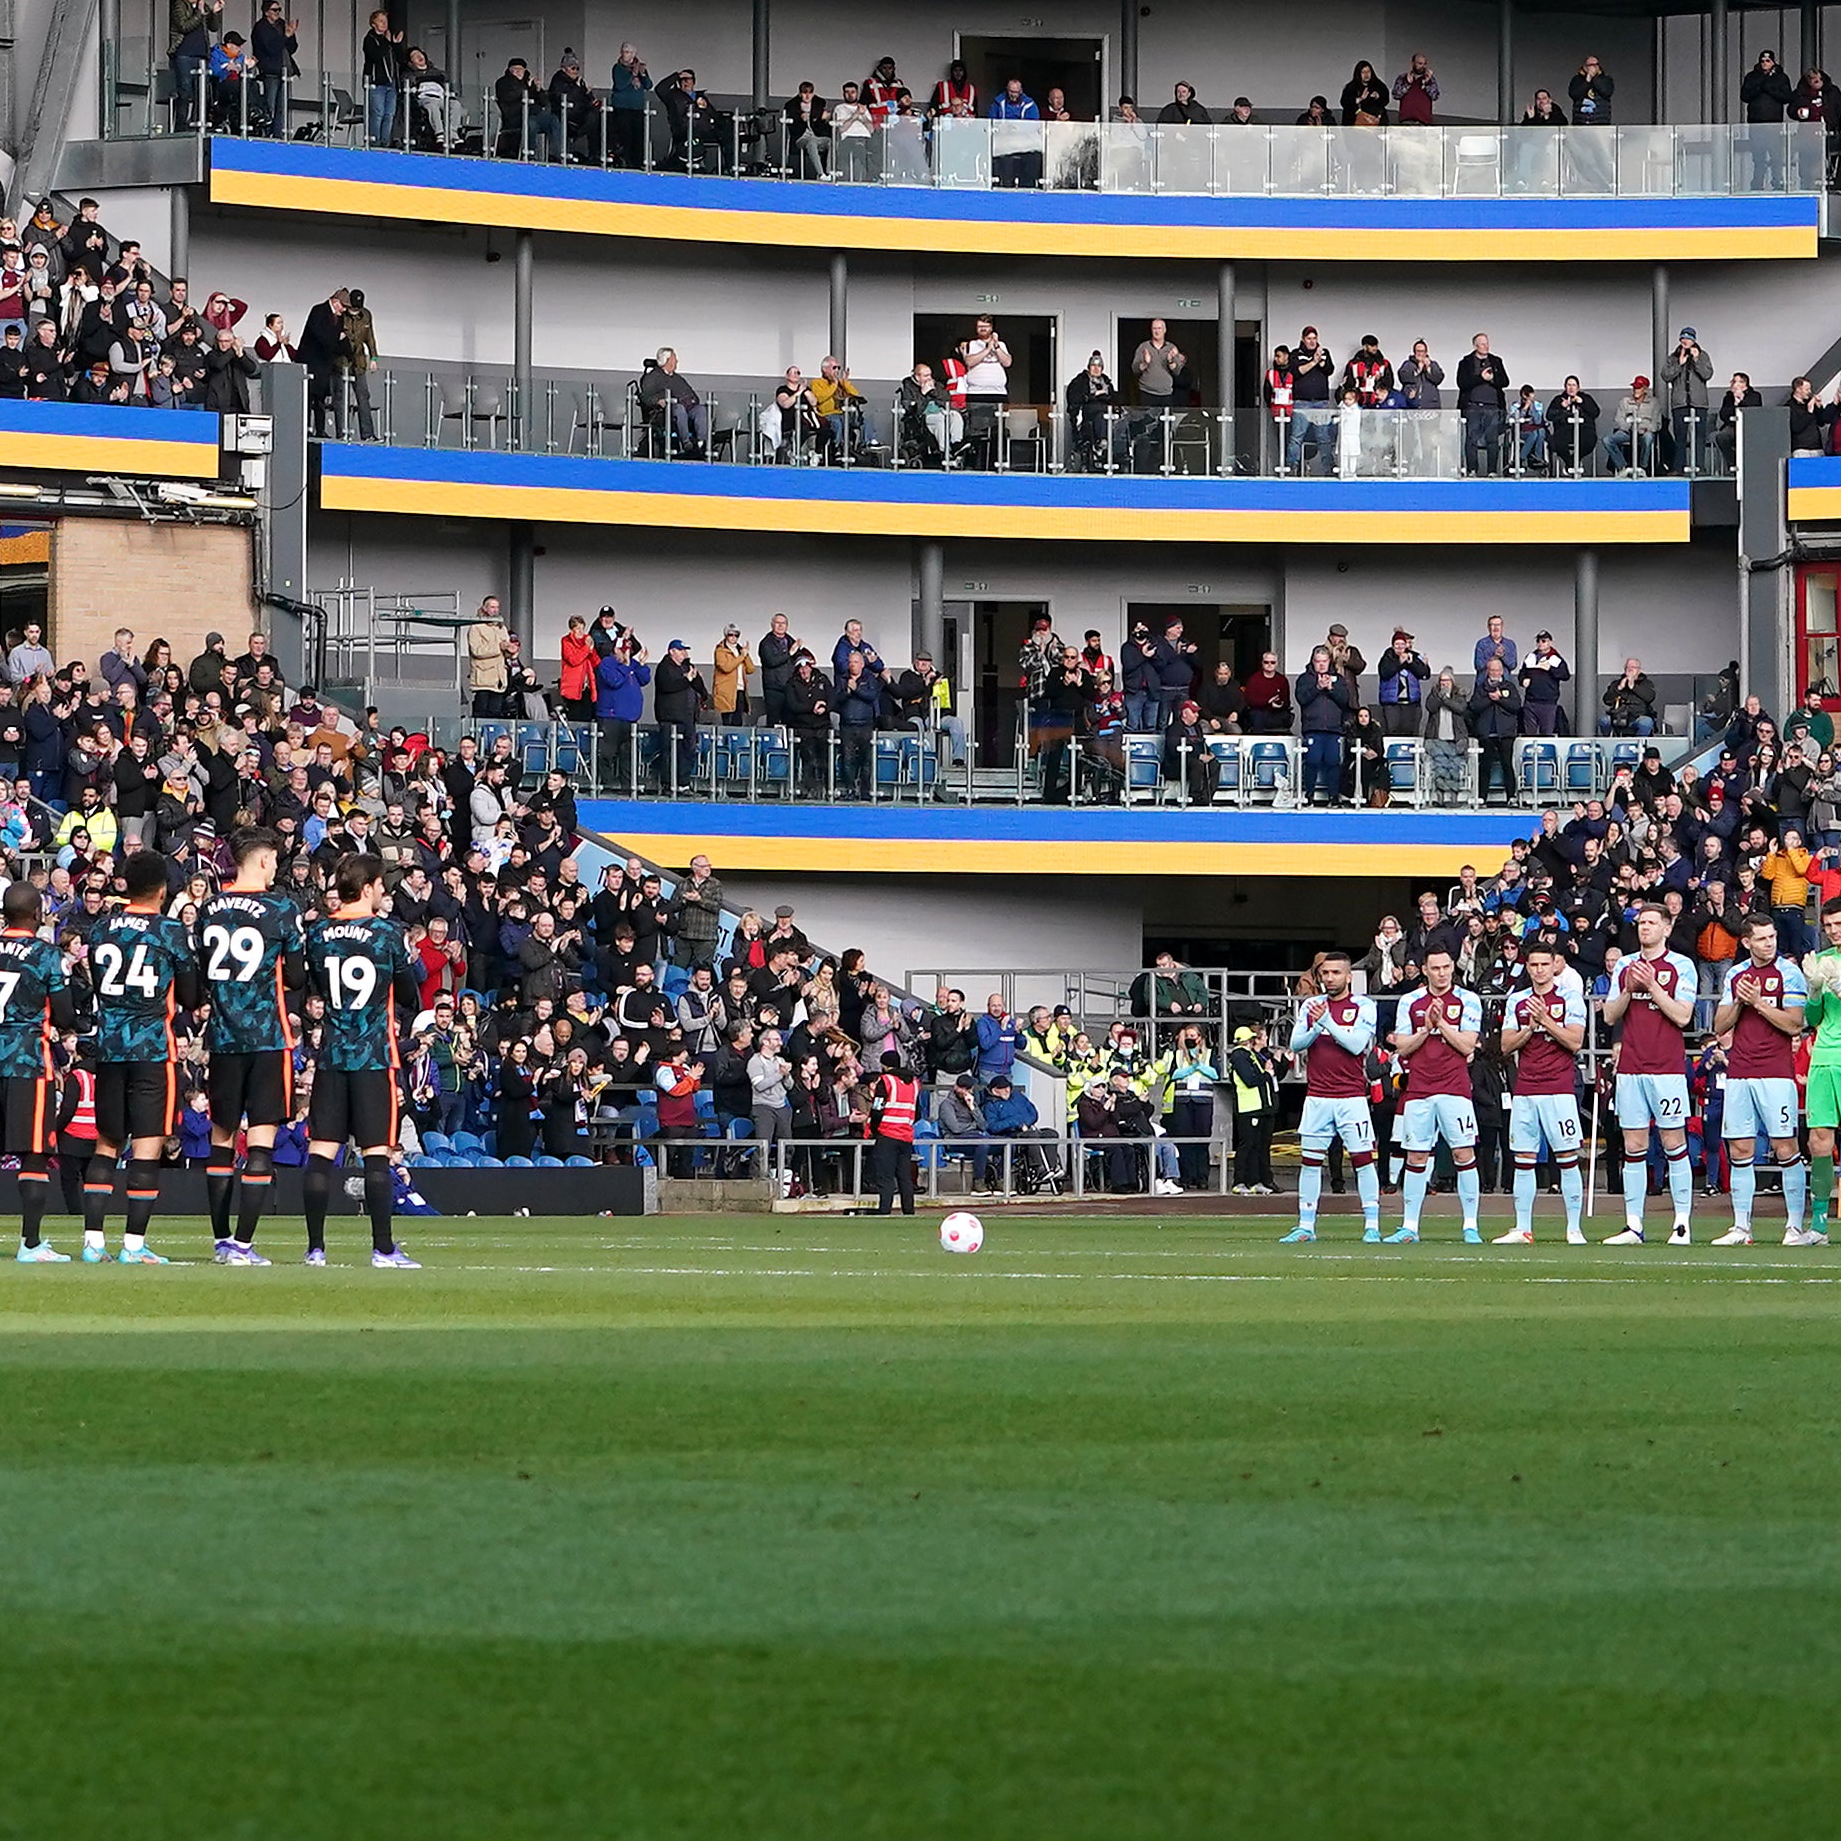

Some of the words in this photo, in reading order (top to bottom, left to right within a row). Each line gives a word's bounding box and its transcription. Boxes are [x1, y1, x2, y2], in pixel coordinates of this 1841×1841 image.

[208, 897, 267, 919] HAVERTZ
[108, 916, 150, 933] JAMES
[322, 925, 374, 943] MOUNT
[203, 924, 264, 982] 29
[94, 943, 158, 998] 24
[324, 955, 377, 1011] 19
[1659, 1097, 1682, 1116] 22
[1780, 1106, 1790, 1124] 5
[1355, 1120, 1369, 1140] 17
[1457, 1115, 1475, 1135] 14
[1558, 1118, 1576, 1138] 18
